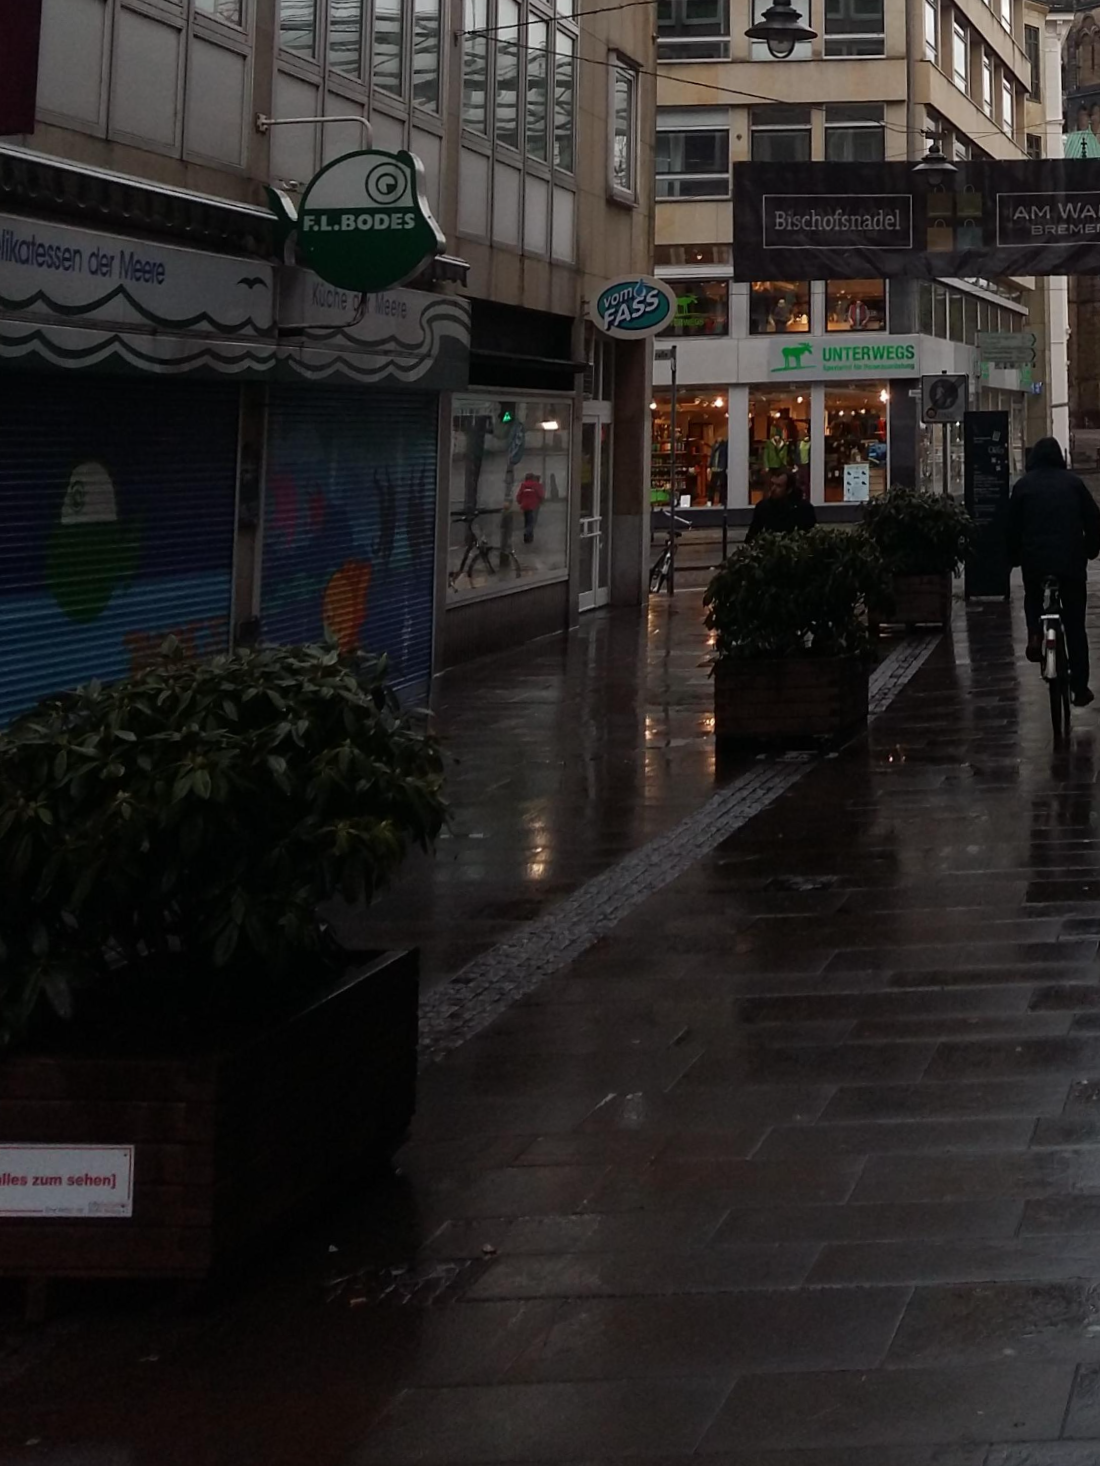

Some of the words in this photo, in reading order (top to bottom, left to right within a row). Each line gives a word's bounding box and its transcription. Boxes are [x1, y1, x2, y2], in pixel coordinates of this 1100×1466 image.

[303, 213, 416, 231] F.L.BODES
[774, 209, 902, 231] Bischofsnadel
[1013, 205, 1050, 220] AM
[0, 229, 83, 273] likatessen
[88, 246, 115, 278] der
[120, 250, 166, 284] Meere
[313, 282, 348, 311] Küche
[376, 292, 408, 319] Meere
[604, 287, 633, 308] vom
[604, 289, 659, 330] FASS
[823, 345, 915, 361] UNTERWEGS
[0, 1172, 27, 1186] lles
[32, 1175, 62, 1186] zum
[67, 1172, 116, 1190] sehen]
